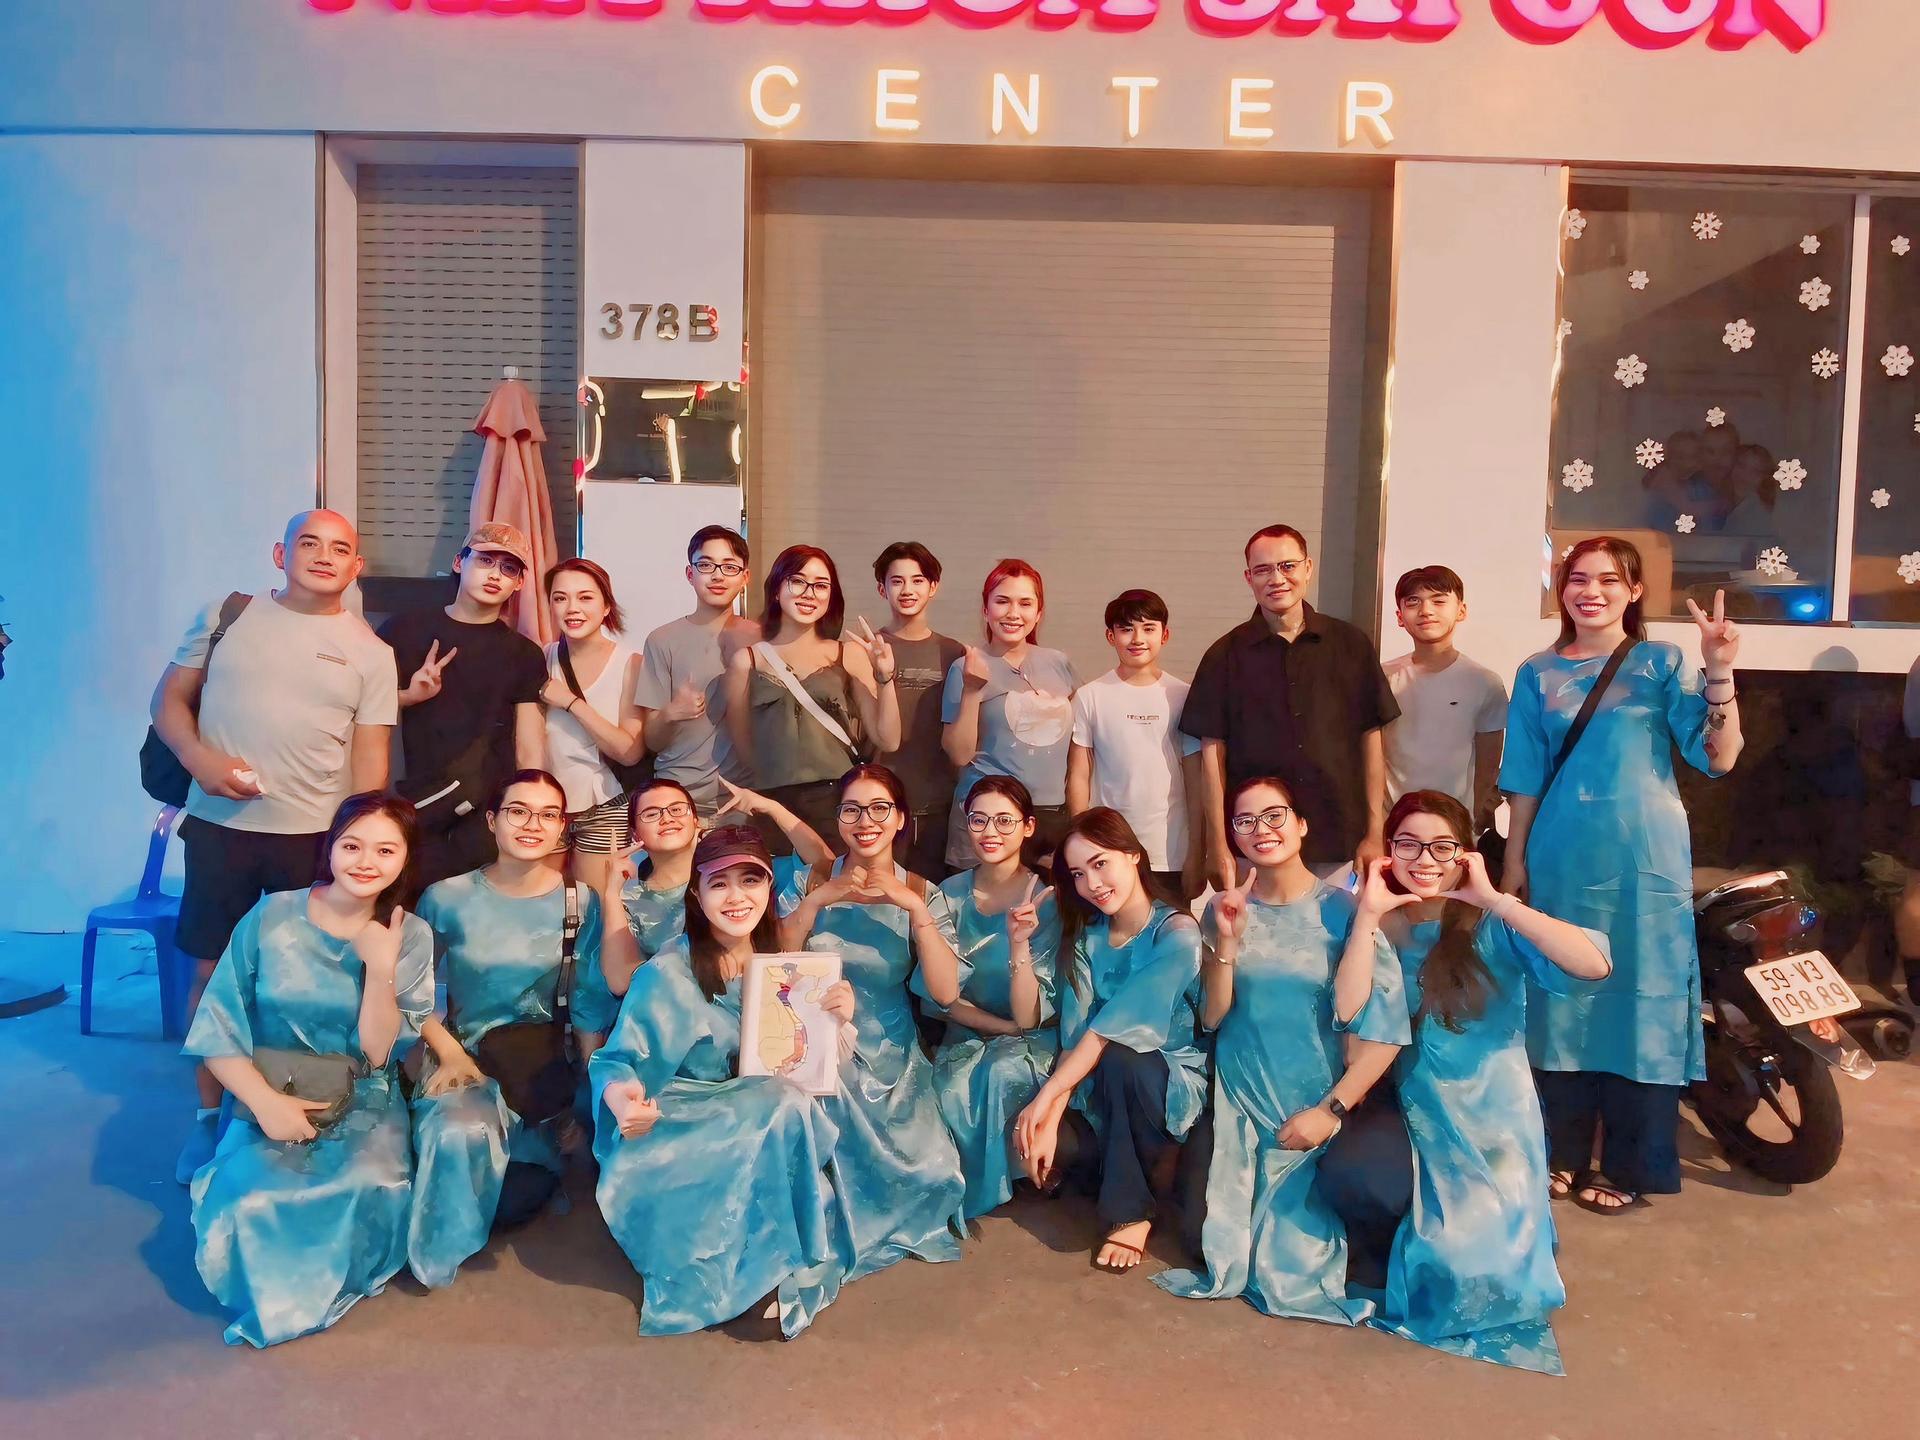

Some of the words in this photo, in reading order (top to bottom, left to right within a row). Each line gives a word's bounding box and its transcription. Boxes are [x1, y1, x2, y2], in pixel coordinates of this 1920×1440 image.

[750, 65, 1395, 142] CENTER
[601, 302, 719, 342] 378B
[1760, 959, 1824, 991] 59-V3
